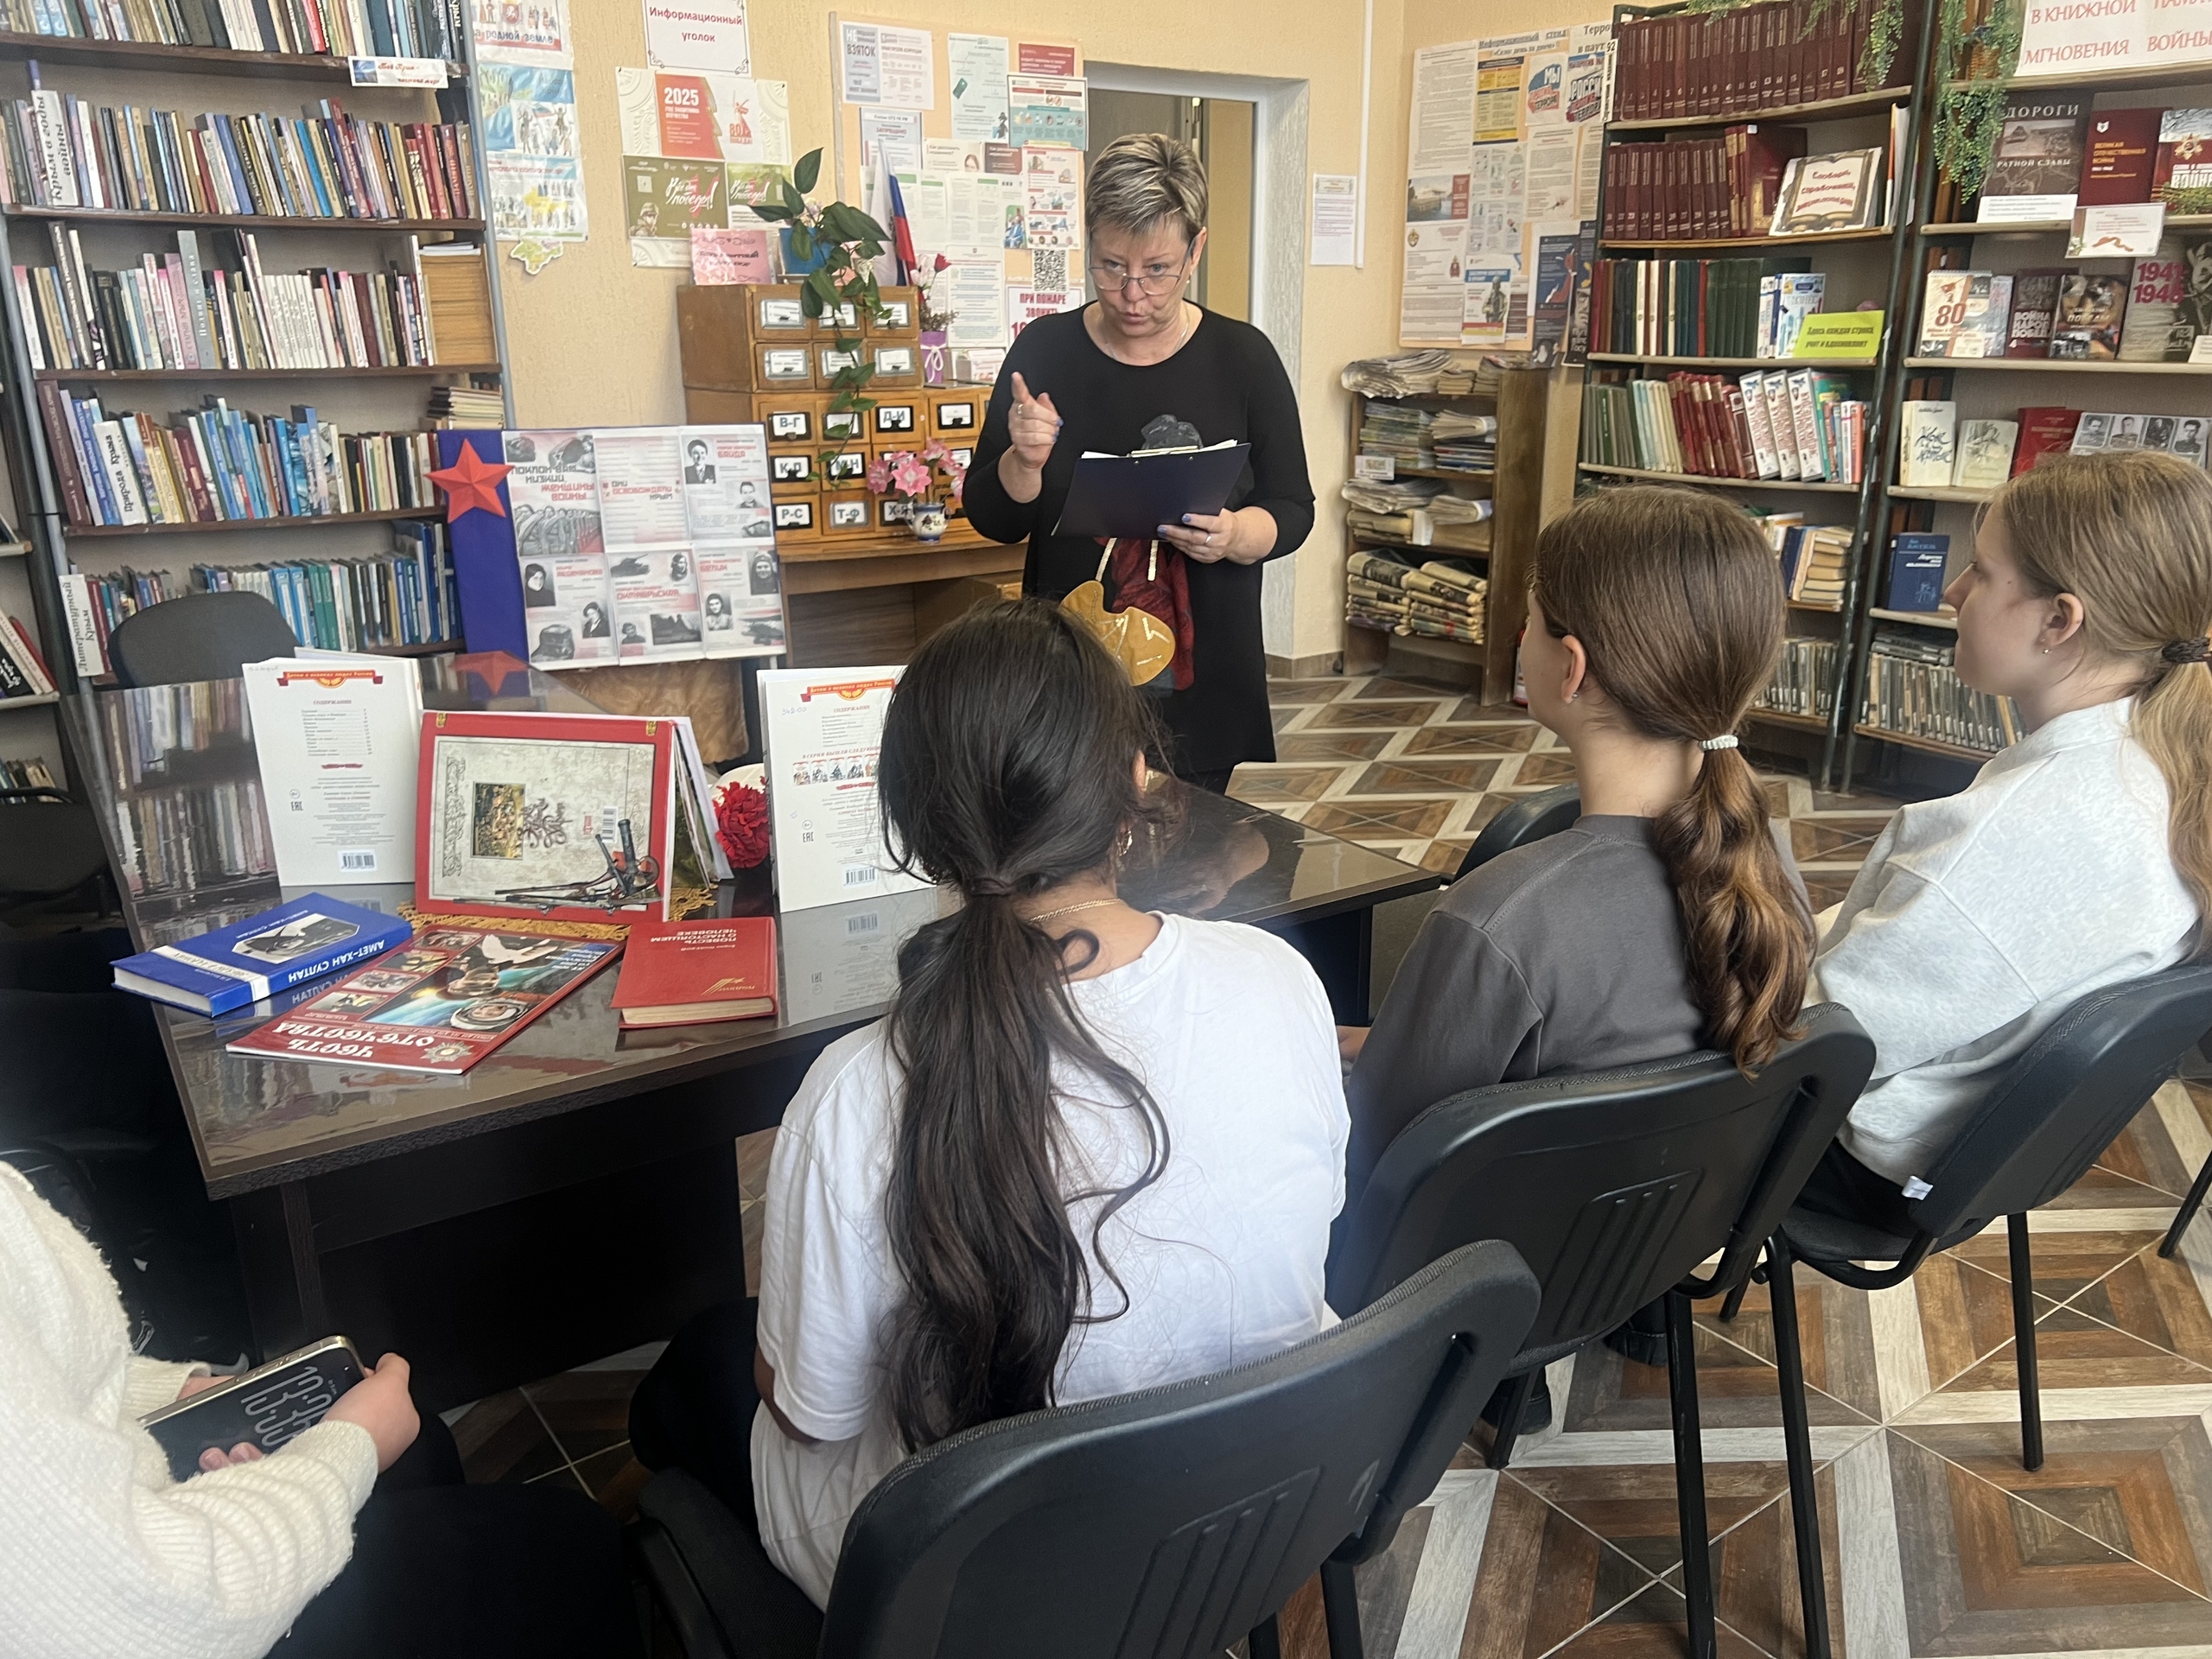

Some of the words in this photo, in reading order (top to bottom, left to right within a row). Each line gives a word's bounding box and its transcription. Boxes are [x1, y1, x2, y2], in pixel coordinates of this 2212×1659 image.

[649, 6, 743, 26] Информационный
[2031, 10, 2040, 24] В
[486, 30, 520, 41] родной
[524, 33, 554, 44] земле
[682, 31, 716, 43] уголок
[846, 29, 857, 42] НЕ
[847, 44, 876, 57] ВЗЯТОК
[2024, 39, 2130, 65] МГНОВЕНИЯ
[1544, 67, 1560, 84] МЫ
[664, 86, 699, 106] 2025
[36, 96, 51, 137] годы
[2005, 105, 2079, 118] ДОРОГИ
[55, 124, 71, 175] войны
[1996, 159, 2035, 168] РАТНОЙ
[2037, 158, 2071, 167] СЛАВЫ
[47, 153, 62, 200] Крым
[1020, 294, 1034, 304] ПРИ
[1036, 294, 1066, 304] ПОЖАРЕ
[1935, 302, 1967, 327] 80
[779, 416, 801, 428] В-Г
[883, 410, 906, 423] Д-И
[105, 435, 120, 465] Крыма
[116, 470, 133, 512] Природа
[781, 508, 804, 519] Р-С
[837, 509, 860, 518] Т-Ф
[62, 582, 88, 672] Литературный
[83, 609, 95, 641] Крым
[651, 934, 726, 943] НАСТОЯЩЕМ
[332, 939, 385, 967] АМЕТ-ХАН
[288, 961, 329, 983] СУЛТАН
[272, 1022, 435, 1047] ОТЕЧЕСТВА
[287, 1039, 374, 1058] ЧЕСТЬ
